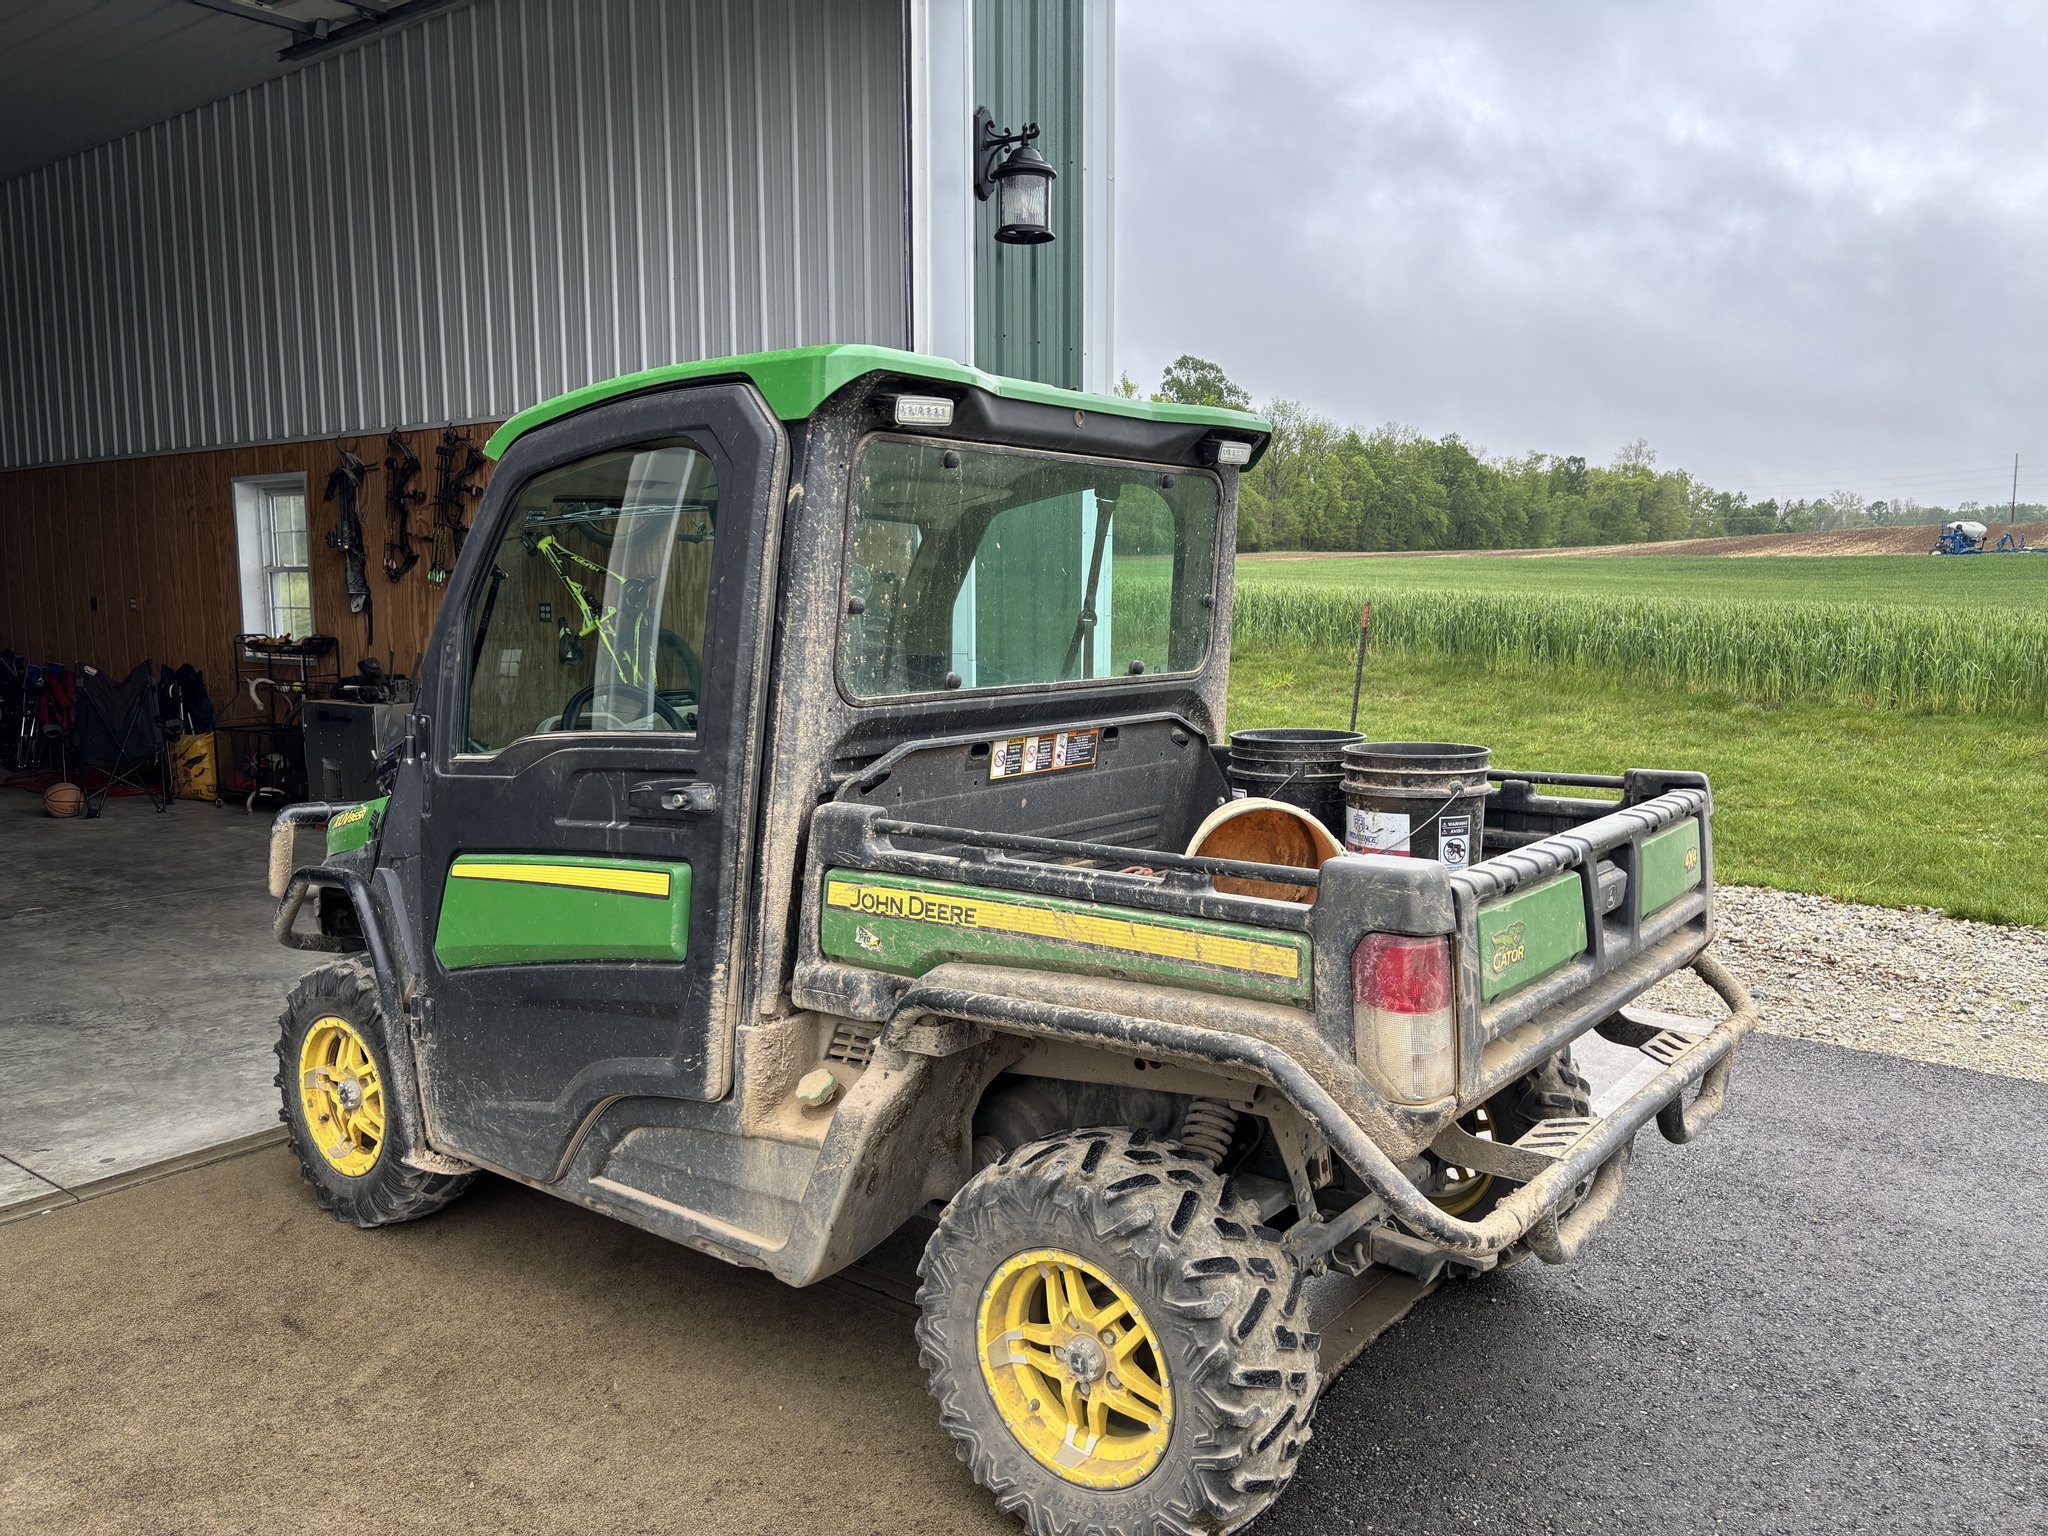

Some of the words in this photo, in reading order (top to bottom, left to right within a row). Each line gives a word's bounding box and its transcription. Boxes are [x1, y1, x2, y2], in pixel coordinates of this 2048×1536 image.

[850, 888, 903, 914] JOHN
[908, 896, 977, 925] DEERE
[1493, 945, 1525, 972] GATOR
